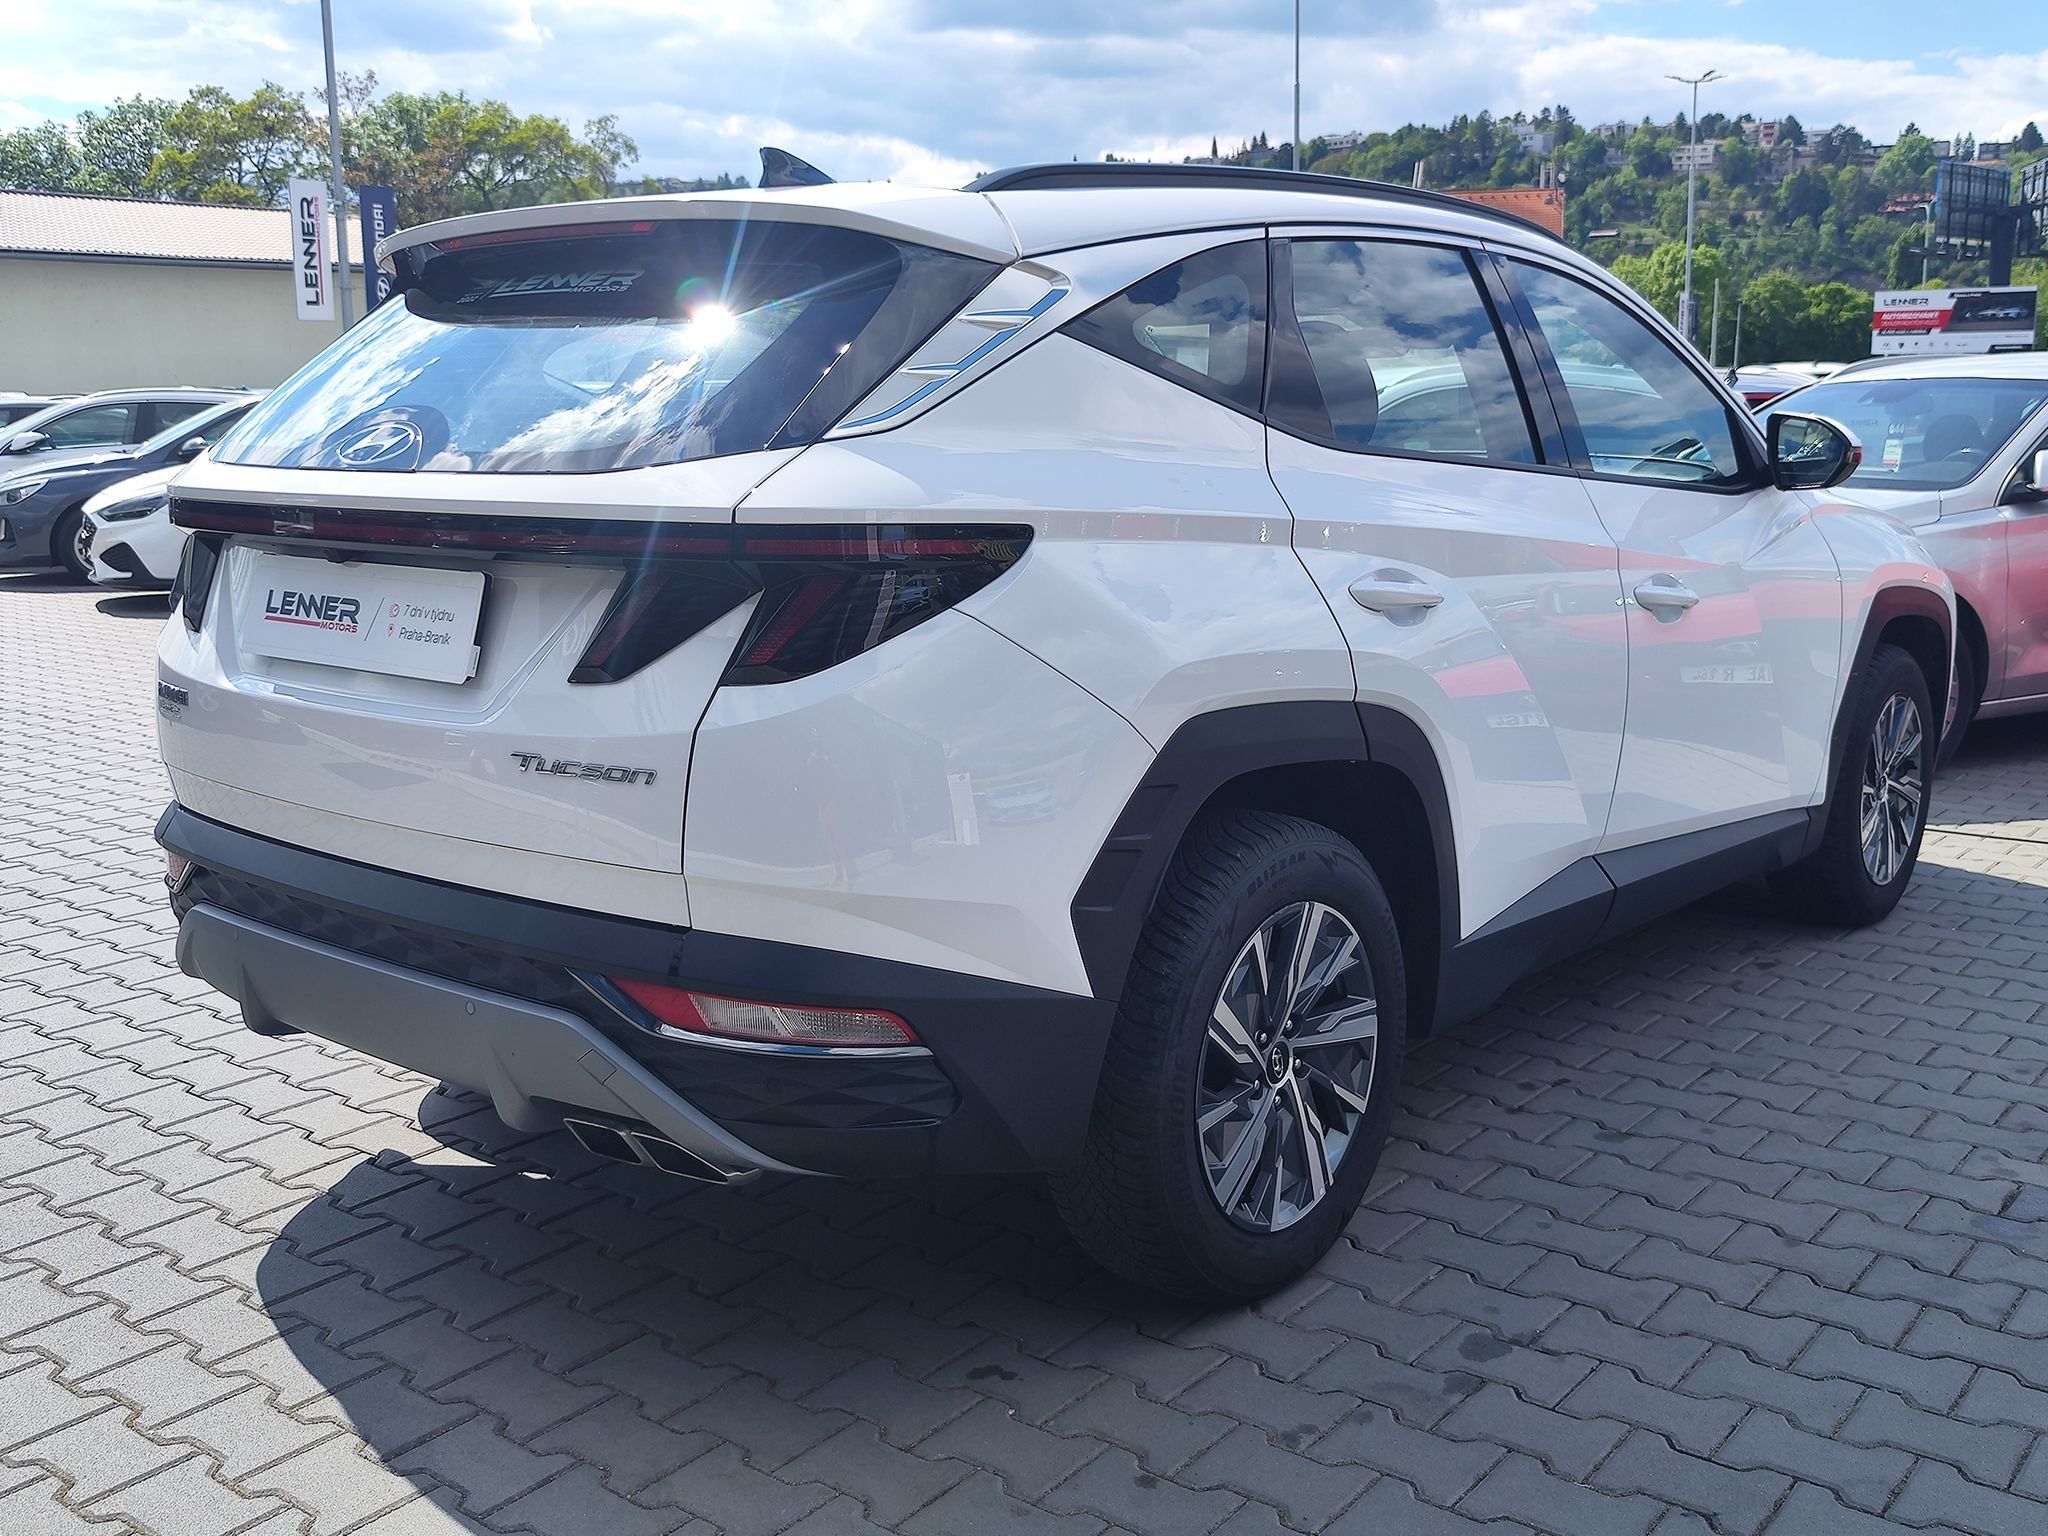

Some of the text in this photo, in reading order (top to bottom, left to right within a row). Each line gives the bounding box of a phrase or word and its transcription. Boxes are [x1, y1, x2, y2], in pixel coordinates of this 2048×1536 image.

[299, 196, 320, 307] LENNER
[494, 269, 646, 293] LENNER
[569, 285, 631, 293] MOTORS
[1883, 298, 1929, 307] LENNER
[265, 589, 361, 625] LENNER
[403, 604, 411, 616] 7
[430, 608, 456, 623] týdnu
[319, 621, 358, 634] MOTORS
[398, 626, 451, 645] Praha-Braník
